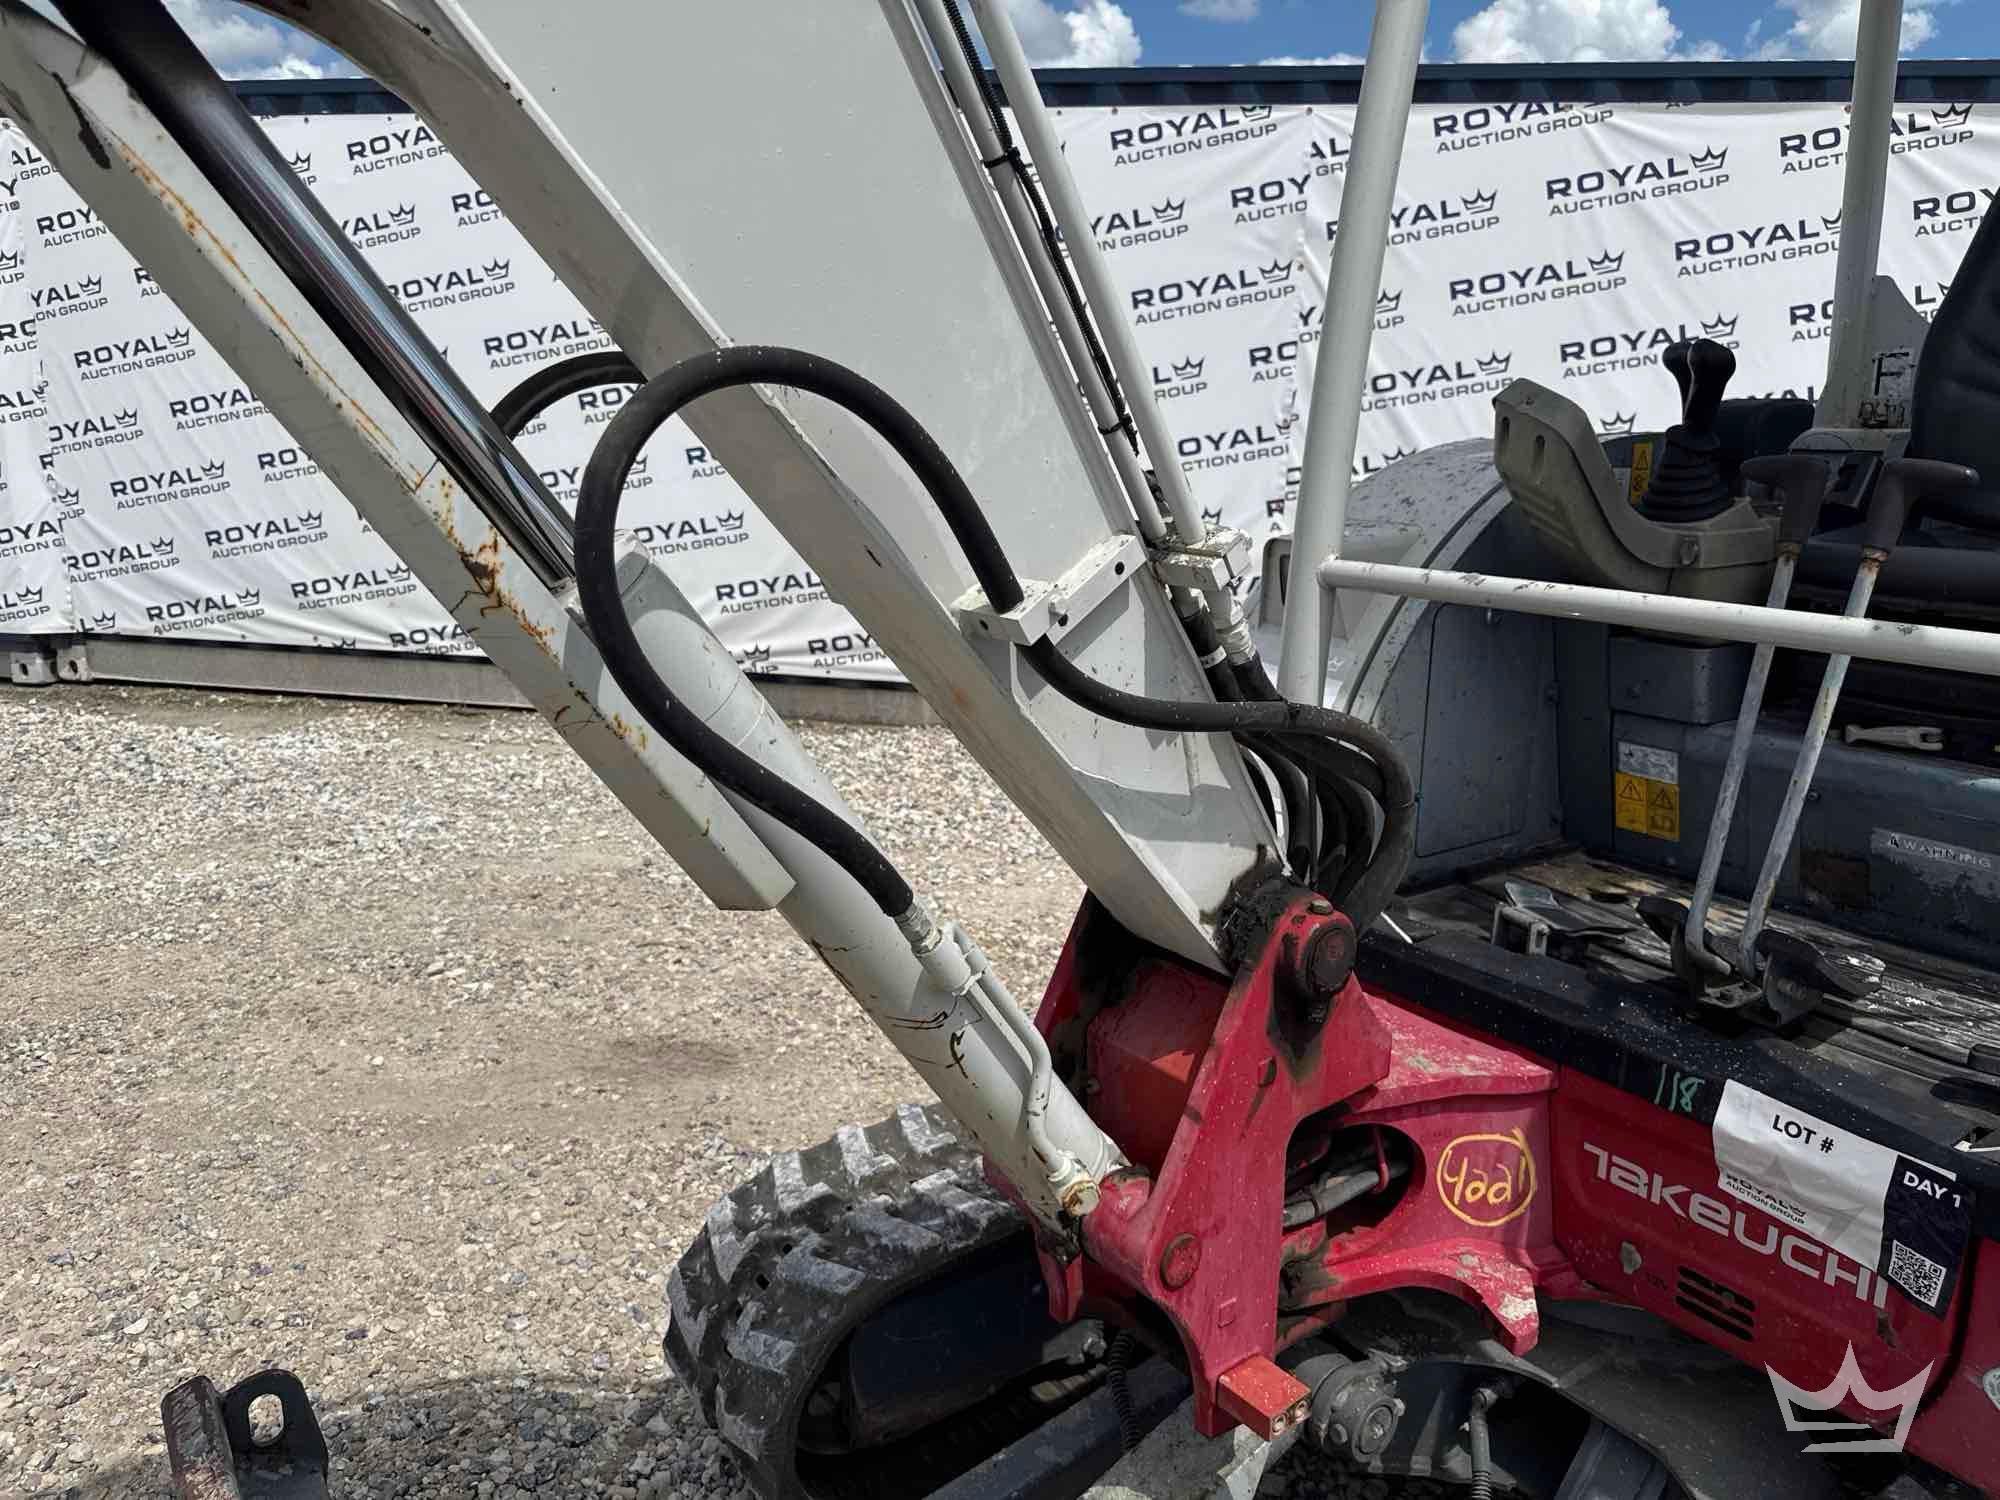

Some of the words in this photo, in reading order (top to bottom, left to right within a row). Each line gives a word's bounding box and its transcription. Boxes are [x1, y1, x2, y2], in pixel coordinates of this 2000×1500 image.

[347, 126, 434, 161] ROYA
[1110, 109, 1239, 151] ROYAL
[1437, 125, 1532, 154] AUCTION
[1537, 109, 1614, 133] GROUP
[1890, 130, 1974, 155] GROUP
[1114, 138, 1201, 167] AUCTION
[1206, 122, 1278, 148] GROUP
[353, 150, 424, 175] AUCTION
[1230, 174, 1311, 209] ROY
[1546, 157, 1689, 201] ROYAL
[1550, 189, 1646, 217] AUCTION
[1651, 174, 1730, 198] GROUP
[36, 207, 95, 235] ROY
[1235, 200, 1308, 225] AUCTIO
[44, 226, 107, 249] AUCTION
[365, 227, 421, 248] GROUP
[1120, 224, 1189, 249] GROUP
[1426, 216, 1500, 240] GROUP
[1675, 219, 1820, 261] ROYAL
[1677, 251, 1776, 278] AUCTION
[459, 282, 515, 302] GROUP
[1131, 270, 1259, 310] ROYAL
[1450, 260, 1587, 300] ROYAL
[31, 284, 80, 308] YAL
[58, 297, 109, 317] GROUP
[1136, 299, 1221, 326] AUCTION
[1226, 285, 1296, 308] GROUP
[1452, 290, 1546, 317] AUCTION
[1551, 276, 1627, 299] GROUP
[74, 335, 167, 369] ROYAL
[484, 321, 590, 355] ROYAL
[1560, 324, 1700, 363] ROYAL
[80, 360, 143, 382] AUCTION
[144, 349, 197, 368] GROUP
[490, 347, 561, 370] AUCTION
[1562, 354, 1658, 379] AUCTION
[1153, 382, 1208, 401] ROUP
[1368, 361, 1475, 395] OYAL
[1361, 391, 1436, 412] UCTION
[176, 411, 241, 431] AUCTION
[95, 430, 144, 448] GROUP
[1178, 426, 1275, 457] OYAL
[110, 467, 203, 498] ROYAL
[264, 464, 318, 484] AUCTIO
[117, 491, 178, 511] AUCTION
[180, 481, 231, 499] GROUP
[205, 518, 299, 547] ROYAL
[212, 541, 274, 560] AUCTION
[276, 531, 328, 549] GROUP
[690, 532, 750, 550] GROUP
[66, 543, 152, 570] ROYAL
[70, 565, 130, 585] AUCTION
[131, 557, 180, 573] GROUP
[291, 570, 387, 599] ROYAL
[298, 593, 362, 611] AUCTION
[365, 583, 417, 601] GROUP
[716, 572, 823, 600] ROYAL
[146, 594, 236, 622] ROYAL
[720, 594, 794, 615] AUCTION
[153, 616, 215, 635] AUCTION
[216, 608, 264, 624] GROUP
[389, 624, 470, 648] ROYA
[808, 633, 872, 655] ROY
[1654, 1063, 1704, 1112] 118
[1772, 1114, 1816, 1144] LOT
[1819, 1136, 1834, 1154] #
[1726, 1180, 1768, 1206] AUCTION
[1903, 1171, 1948, 1200] DAY
[1952, 1194, 1961, 1208] 1
